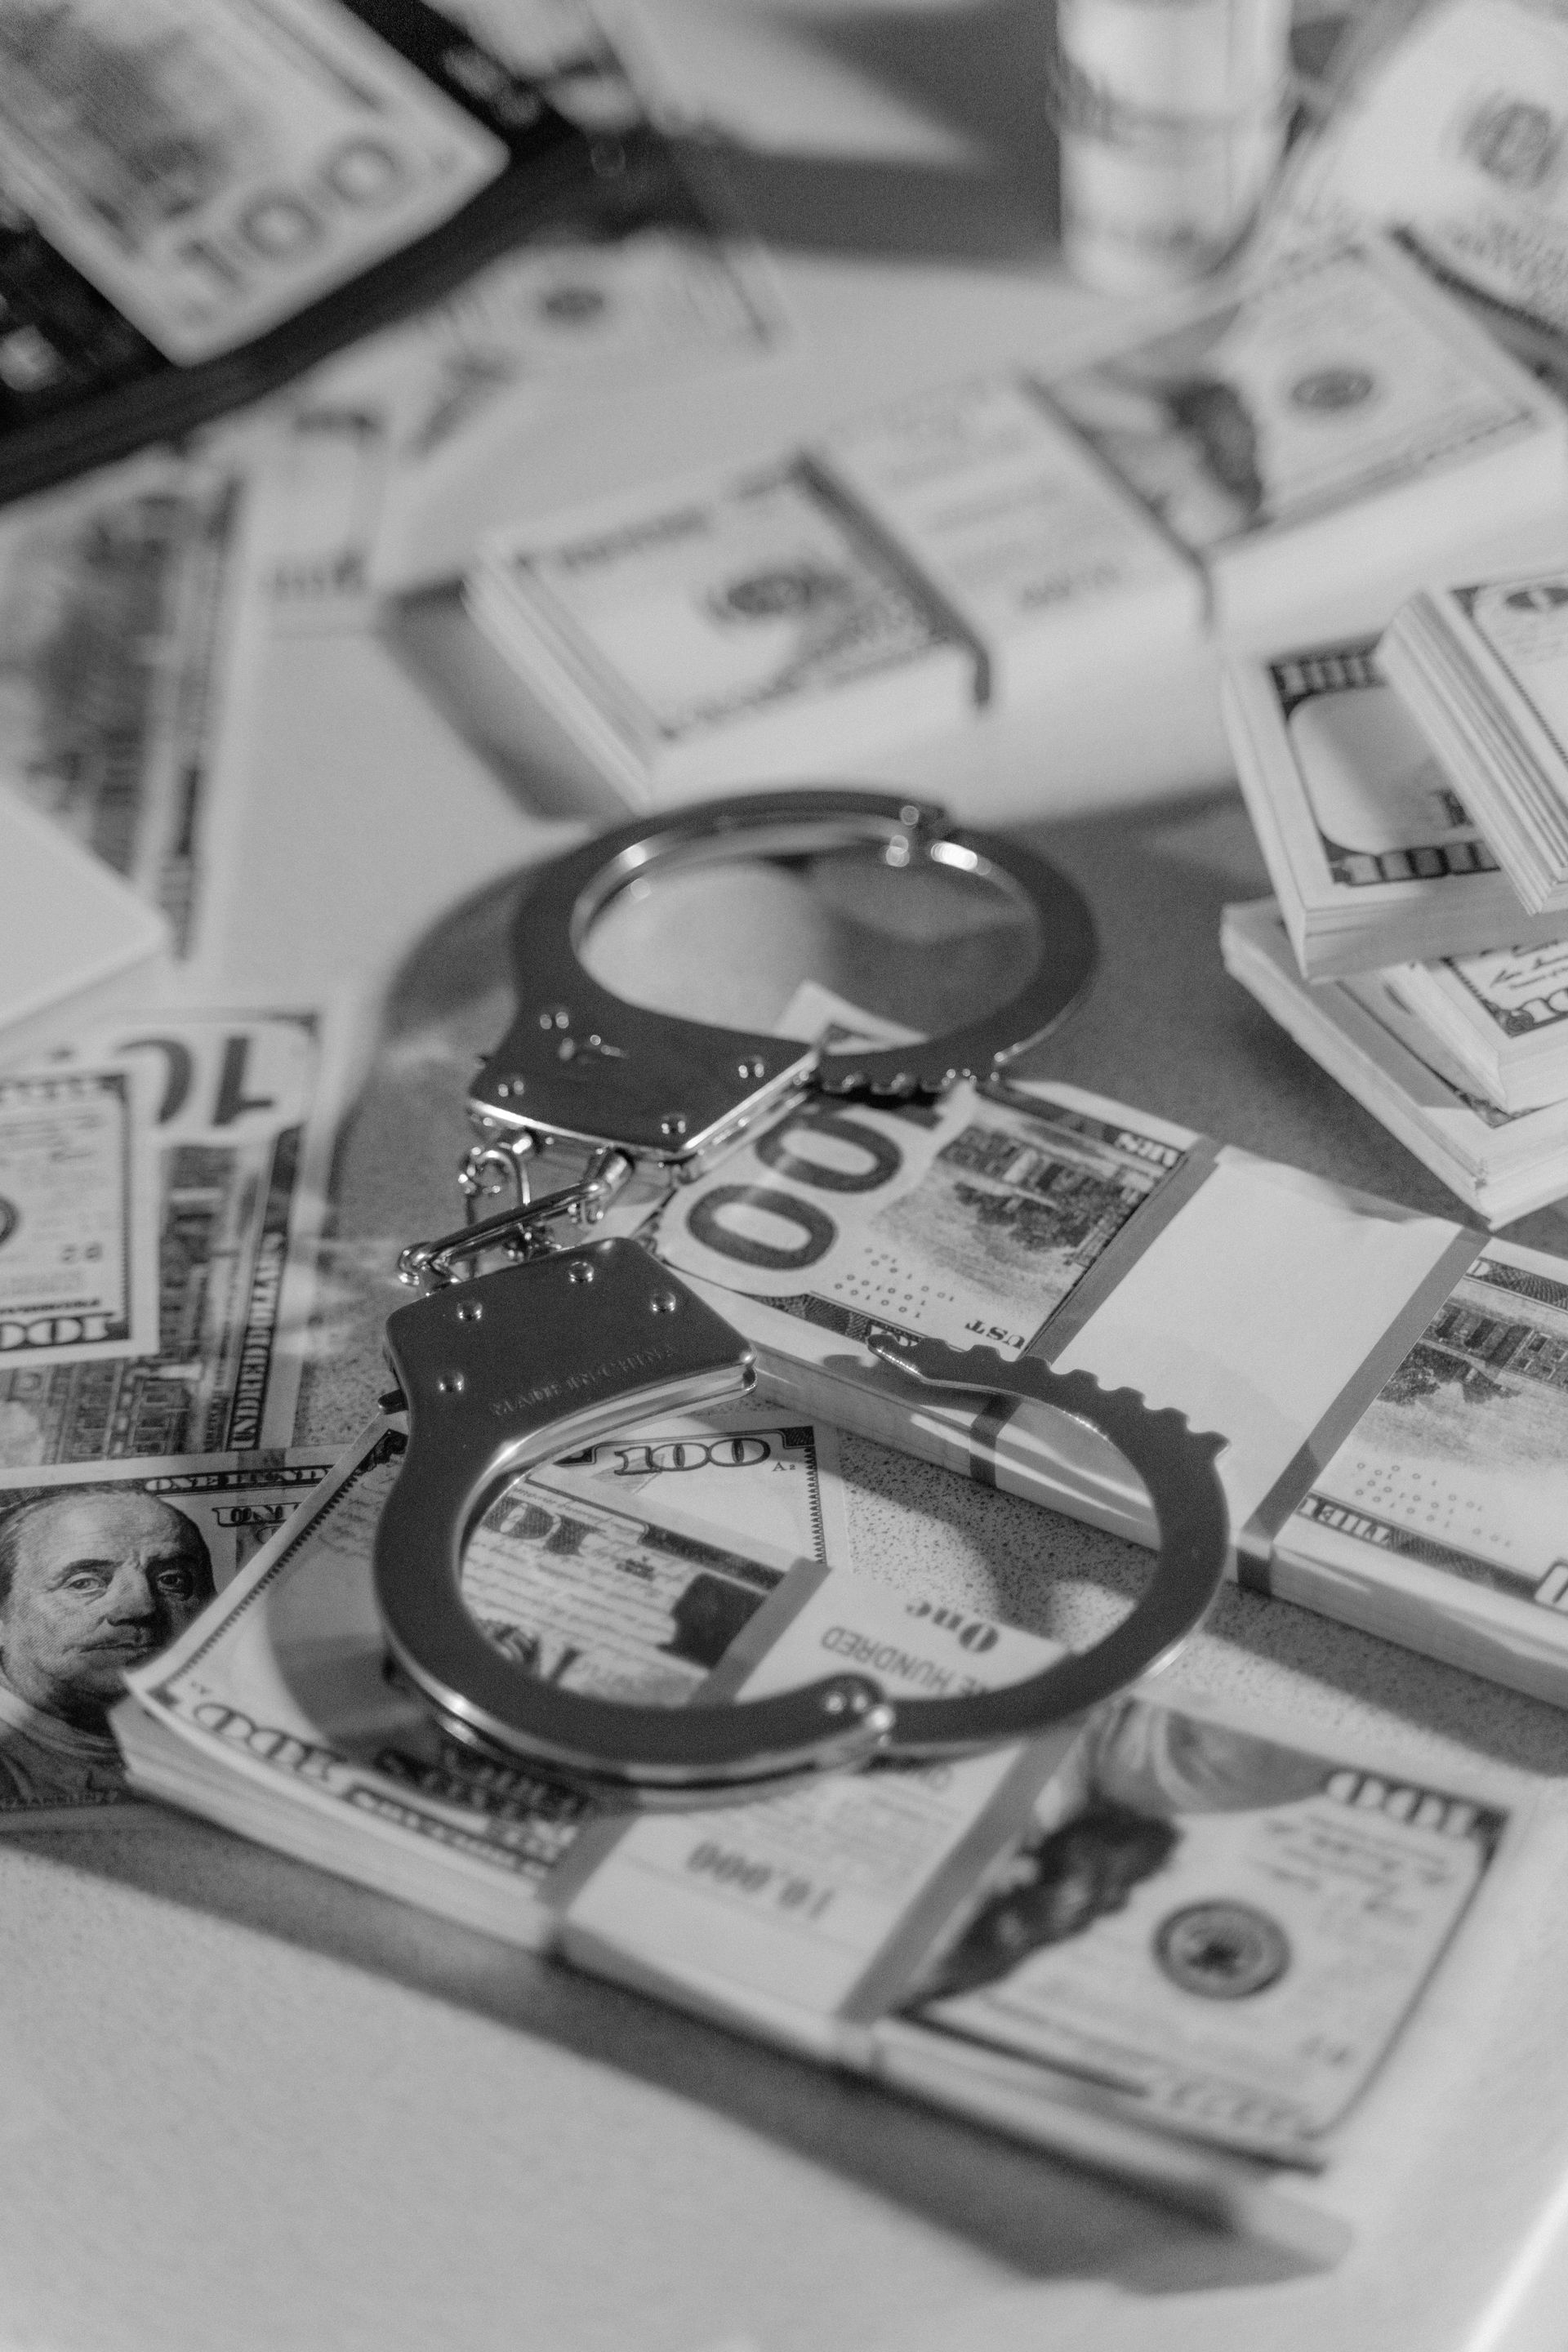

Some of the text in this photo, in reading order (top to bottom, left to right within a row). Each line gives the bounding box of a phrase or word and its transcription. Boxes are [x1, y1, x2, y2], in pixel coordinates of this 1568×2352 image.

[614, 1437, 771, 1476] 100
[145, 1475, 219, 1491] ONE
[906, 1600, 1000, 1653] One
[821, 1626, 956, 1696] HUNDRED
